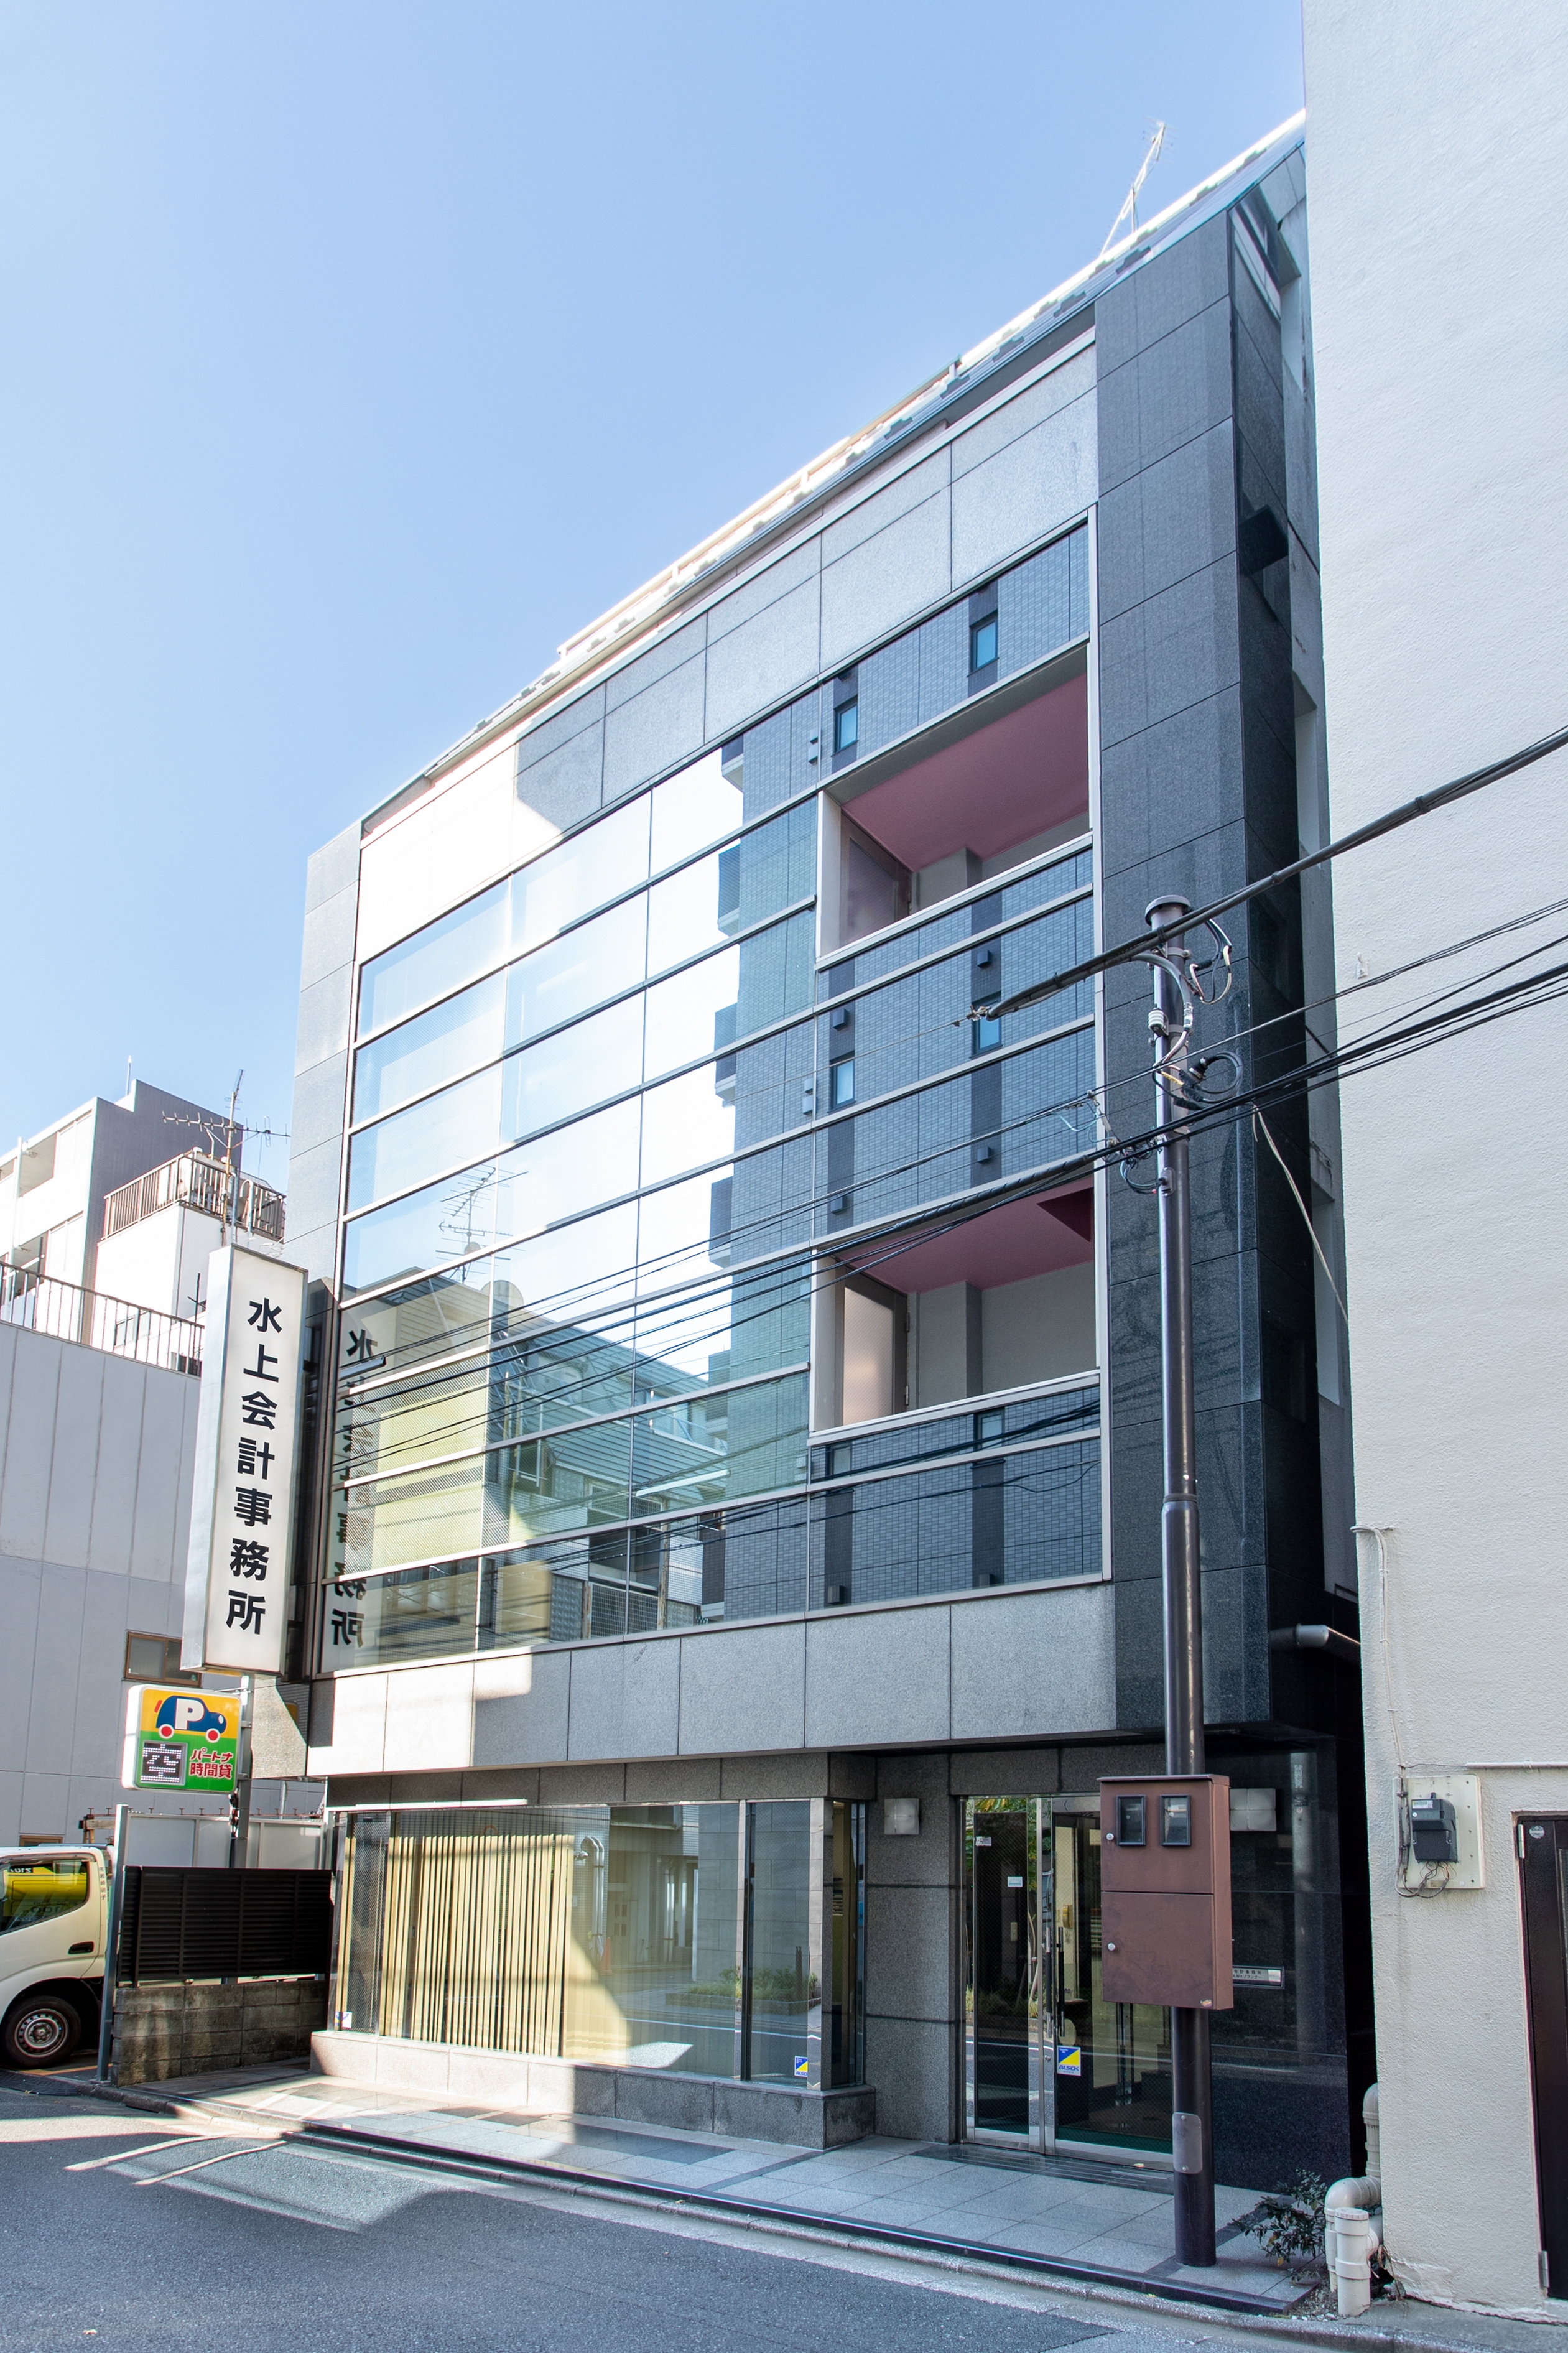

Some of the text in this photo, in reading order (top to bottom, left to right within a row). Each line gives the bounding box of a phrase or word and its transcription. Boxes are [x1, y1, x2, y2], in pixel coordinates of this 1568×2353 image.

[225, 1297, 282, 1635] 水上会計事務所
[175, 1698, 205, 1730] P
[141, 1743, 182, 1783] 空
[189, 1762, 233, 1778] 時間貸
